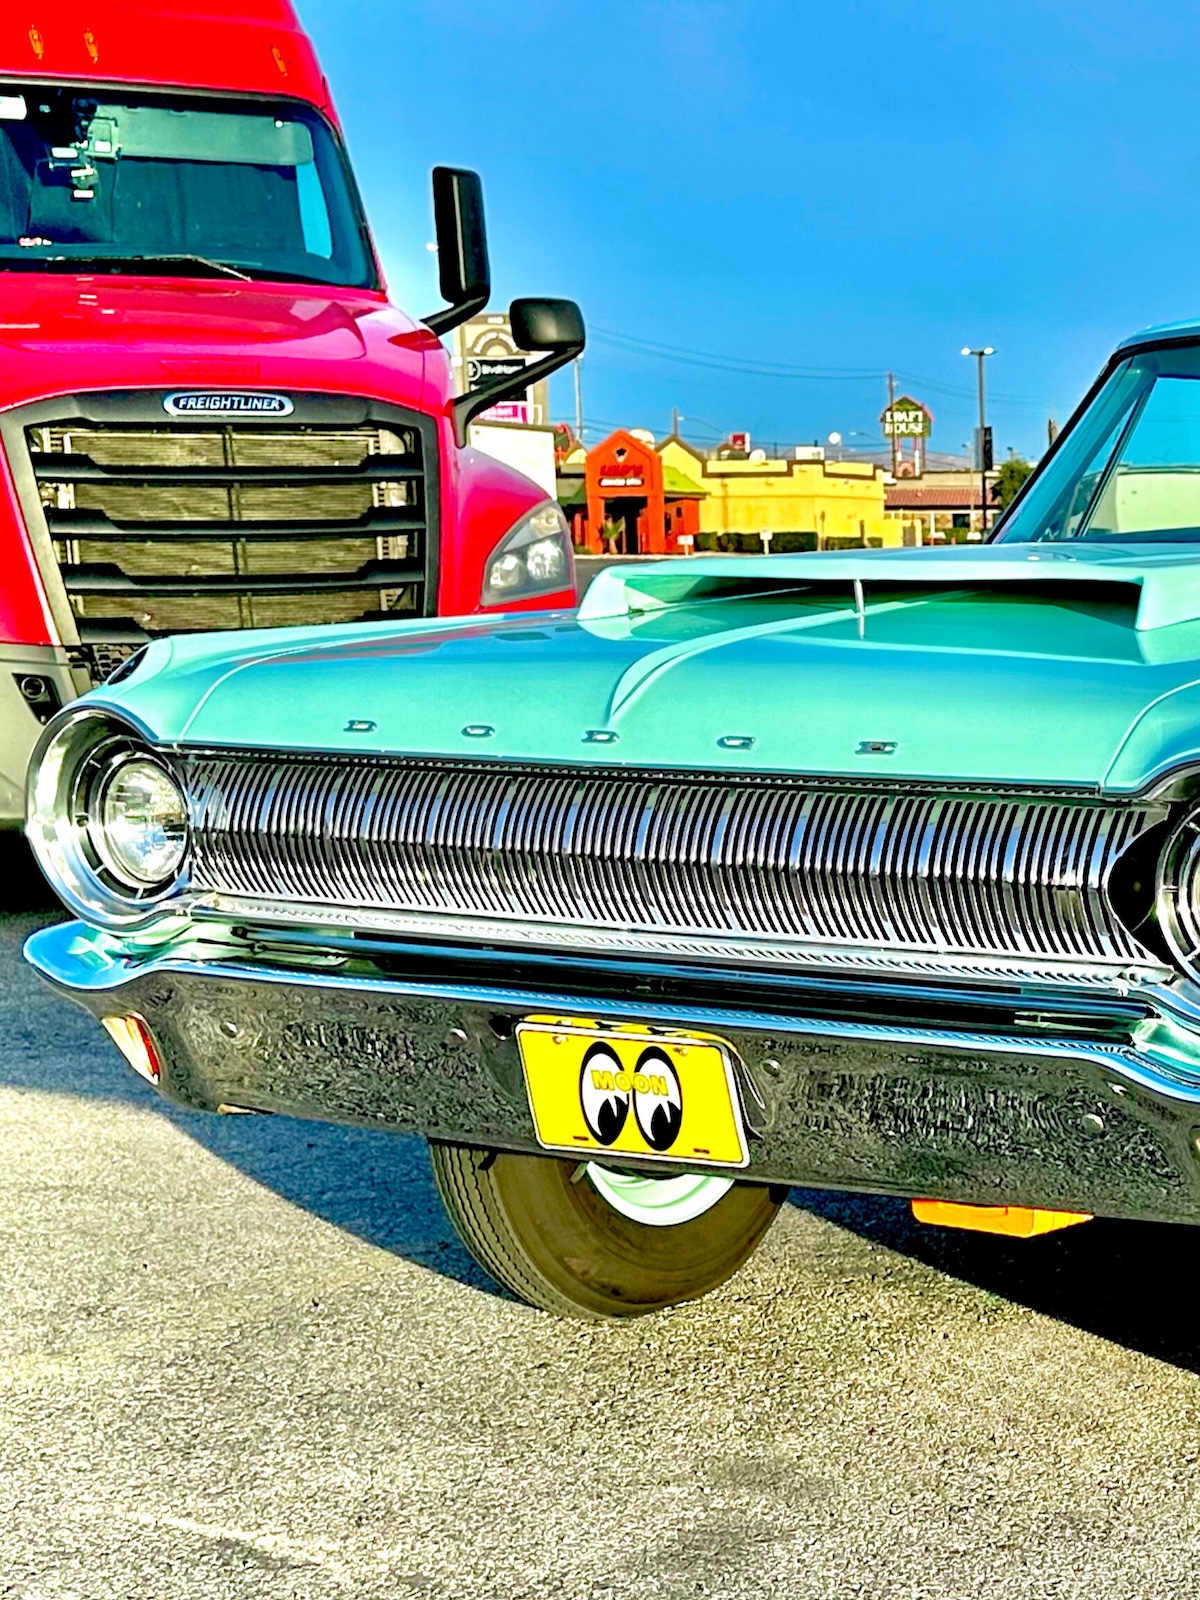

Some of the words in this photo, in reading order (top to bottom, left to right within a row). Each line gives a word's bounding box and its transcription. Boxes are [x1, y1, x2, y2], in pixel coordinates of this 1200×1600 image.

[178, 396, 280, 410] FREIGHTLINER
[885, 423, 923, 434] HOUSE
[343, 718, 898, 756] DODGE
[590, 1069, 669, 1097] MOON
